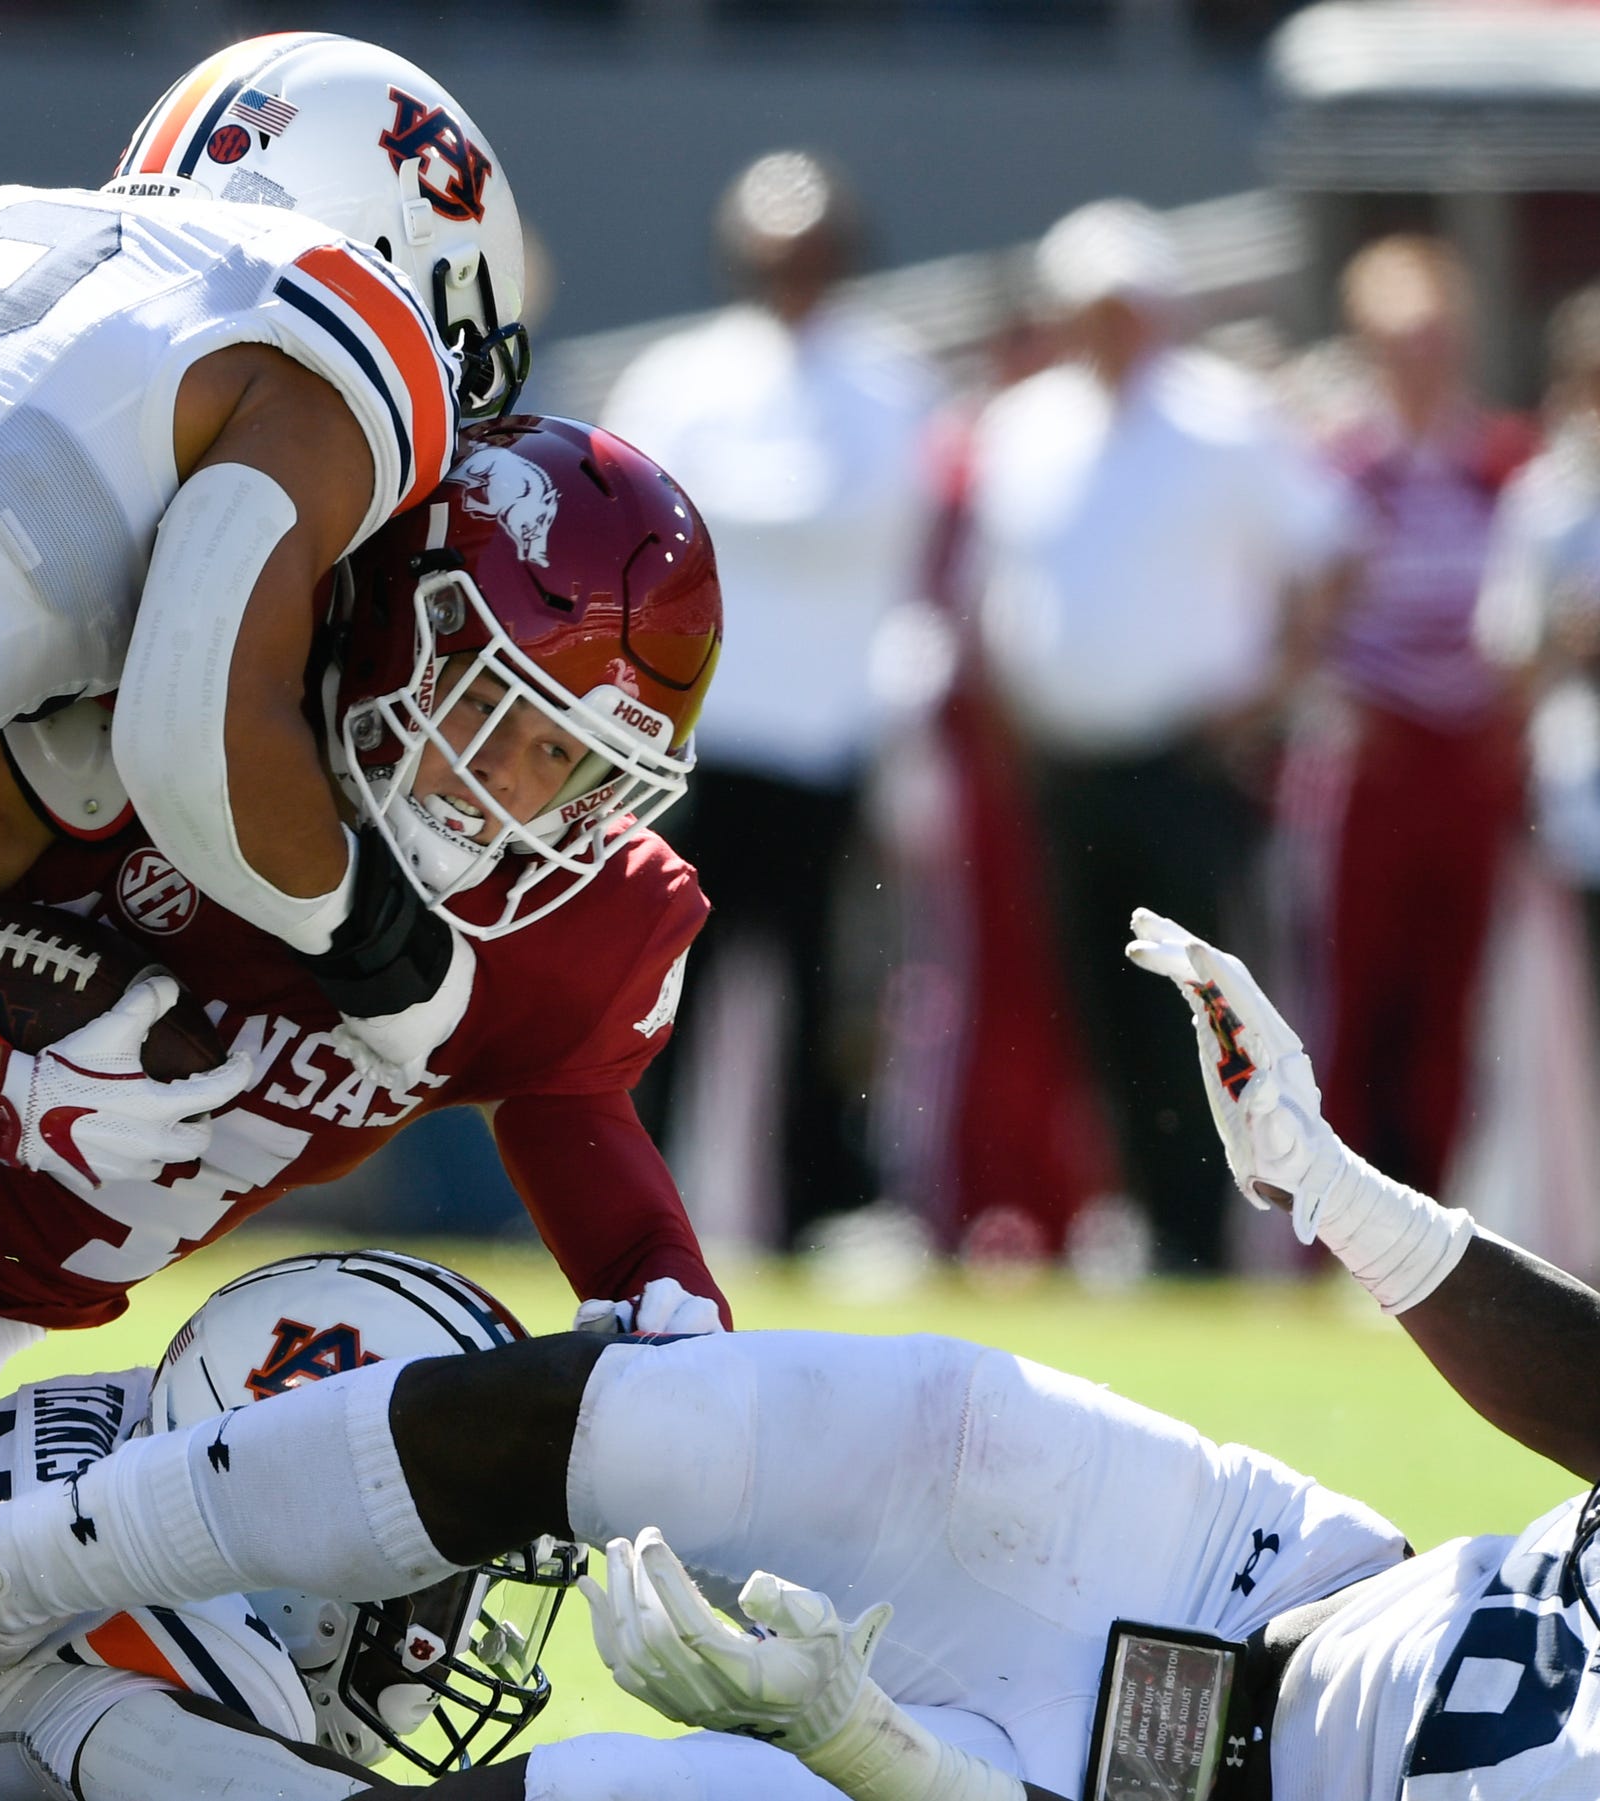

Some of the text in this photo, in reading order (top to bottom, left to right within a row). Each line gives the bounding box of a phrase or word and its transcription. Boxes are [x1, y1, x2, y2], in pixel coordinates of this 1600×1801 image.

[208, 127, 250, 162] SEC
[612, 700, 663, 738] HOGS
[122, 854, 190, 929] SEC
[203, 1000, 452, 1129] NSAS
[1141, 1685, 1154, 1714] STUFF
[1157, 1722, 1168, 1744] ODD
[1165, 1649, 1179, 1690] BOSTON
[1180, 1686, 1192, 1719] ADJUST
[1196, 1688, 1211, 1728] BOSTON
[1138, 1716, 1150, 1740] BACK
[1175, 1720, 1187, 1746] PLUS
